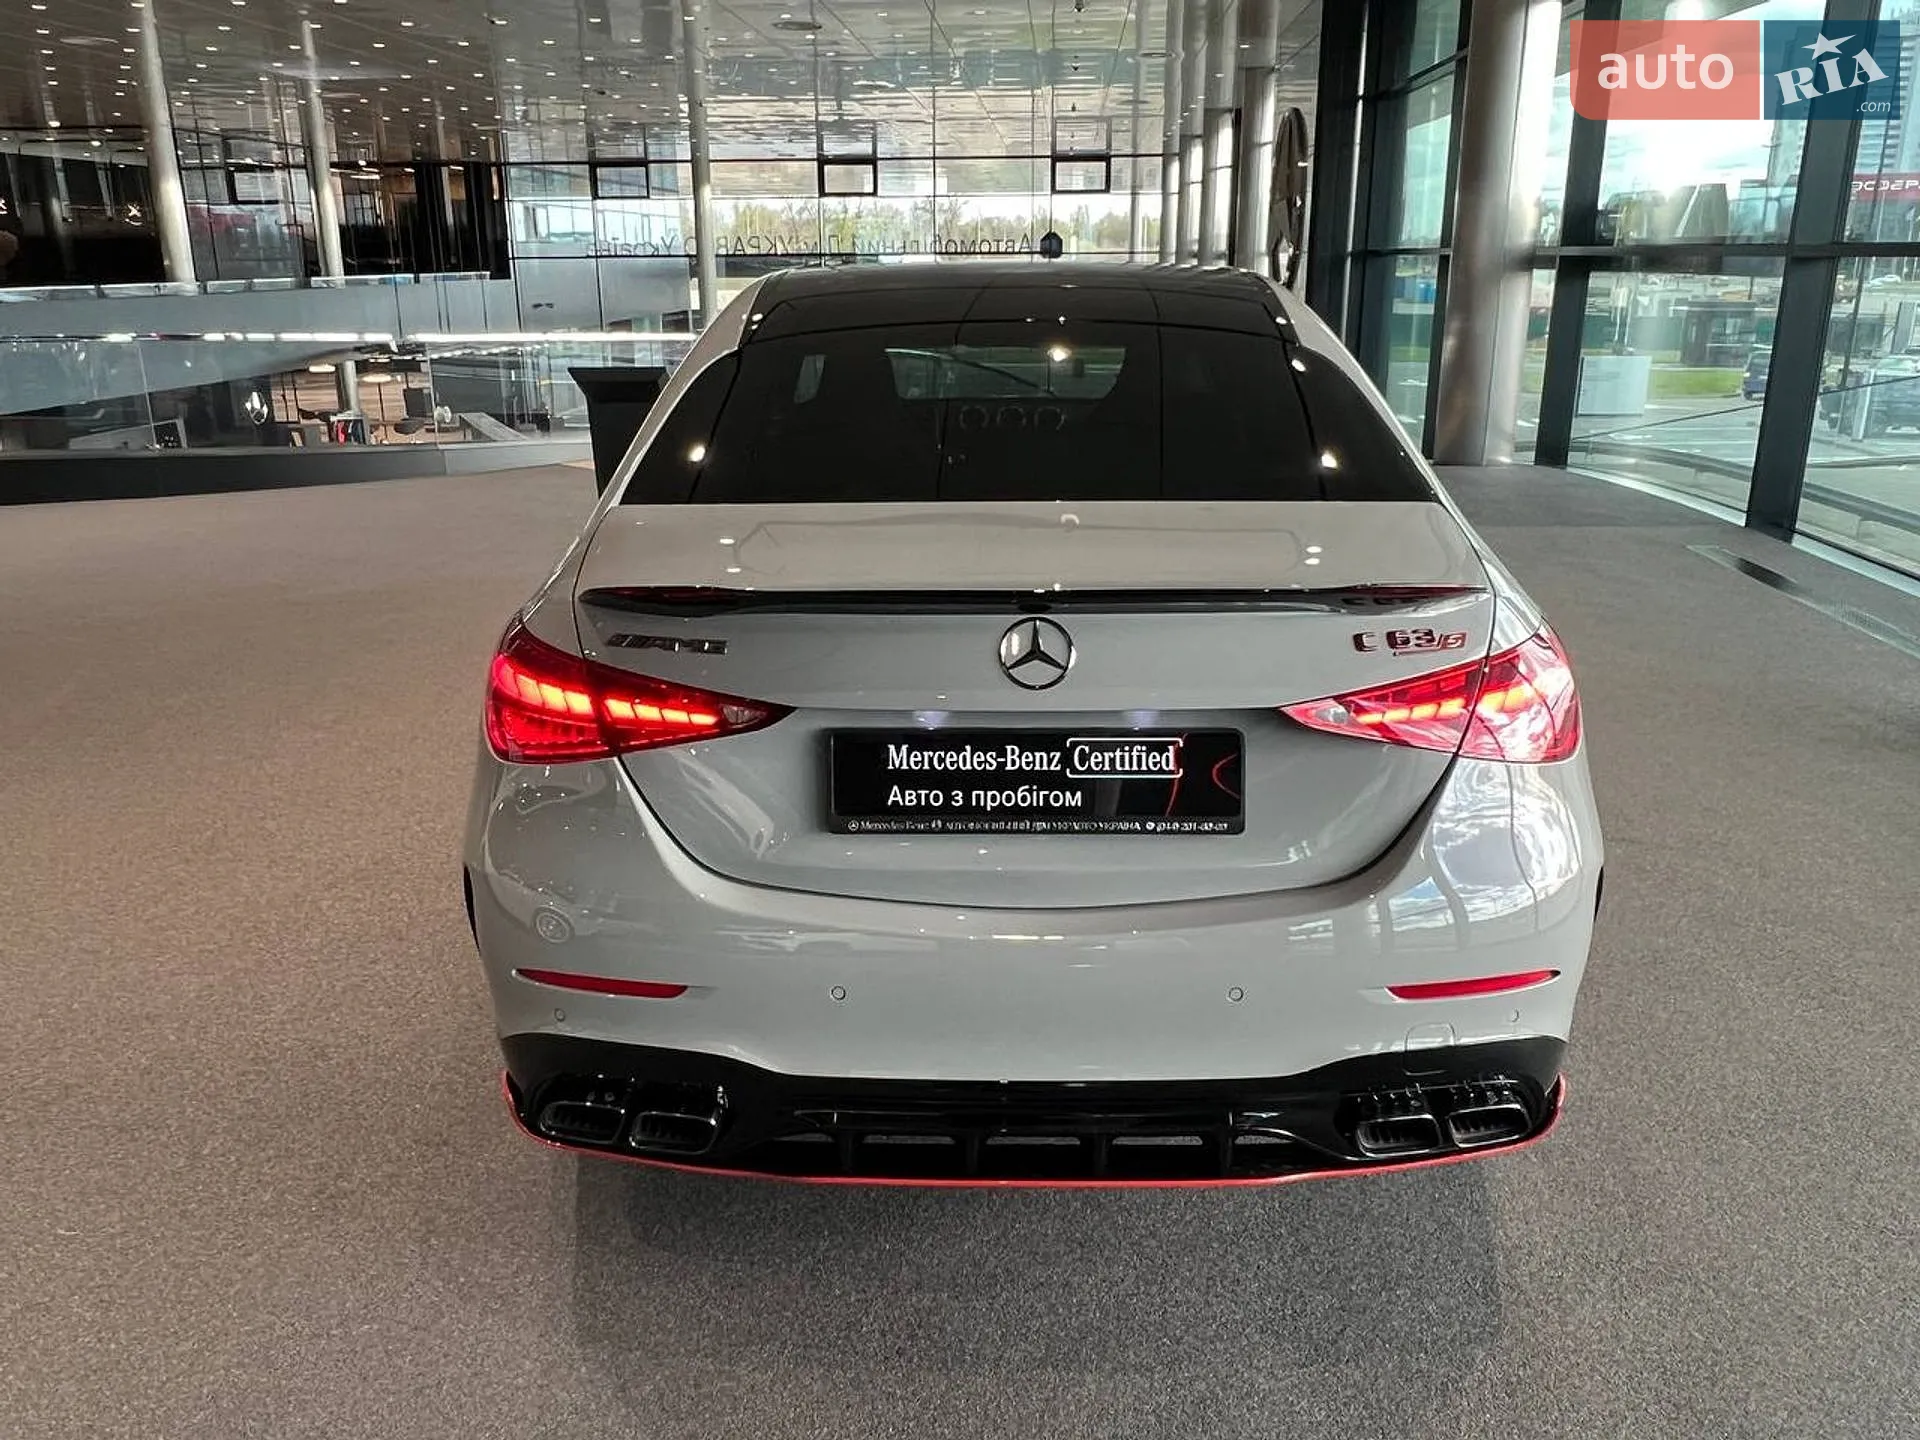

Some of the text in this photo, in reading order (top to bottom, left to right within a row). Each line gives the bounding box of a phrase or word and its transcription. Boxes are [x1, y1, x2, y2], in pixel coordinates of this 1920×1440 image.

[1353, 632, 1377, 651] C
[887, 743, 1176, 771] Mercedes-Benz Certified
[887, 784, 1082, 812] Авто з пробігом
